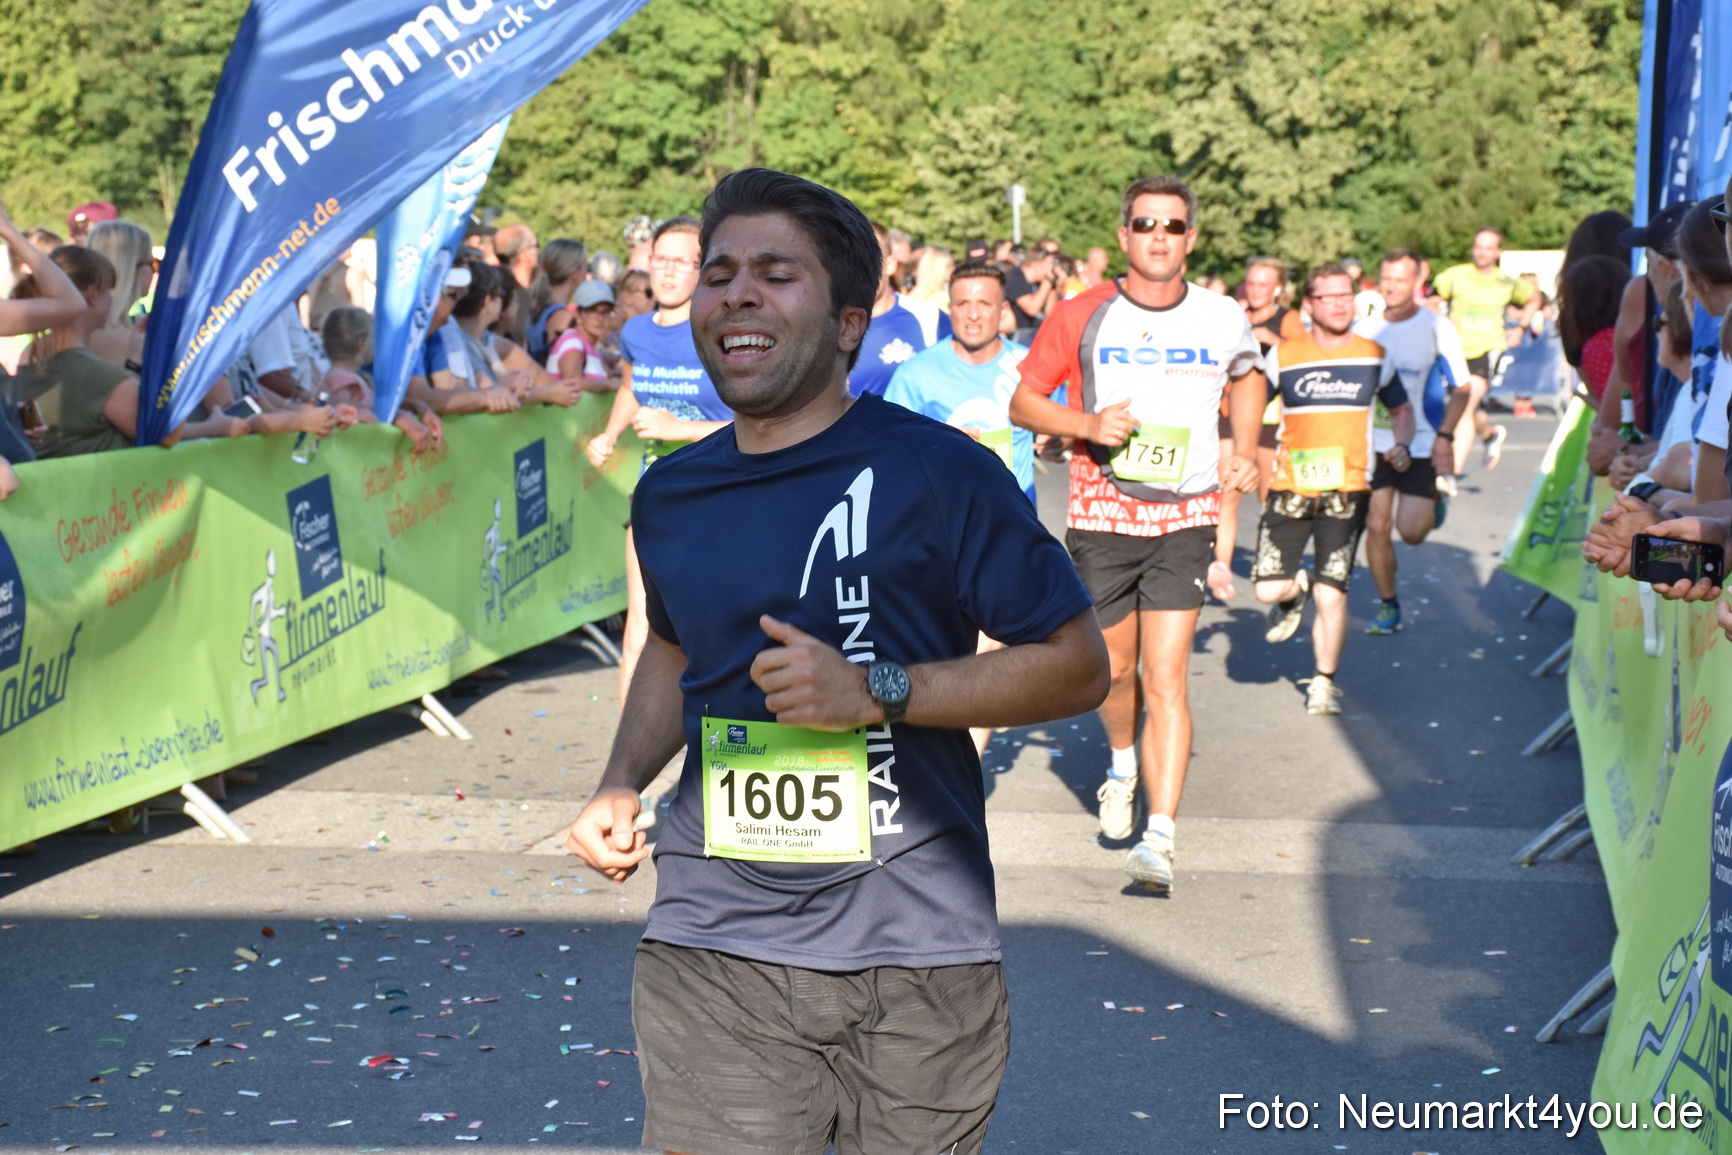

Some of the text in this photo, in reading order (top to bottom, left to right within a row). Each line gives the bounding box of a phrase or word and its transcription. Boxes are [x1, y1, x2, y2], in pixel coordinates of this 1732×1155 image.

[445, 4, 532, 79] Druck
[1124, 443, 1177, 466] 1751
[1301, 463, 1330, 478] 619
[286, 547, 386, 664] firmenlauf
[720, 740, 767, 755] firmenlauf
[774, 755, 805, 766] 2018
[720, 770, 843, 822] 1605
[735, 822, 821, 837] Salimi Hesam
[785, 839, 813, 848] GmbH
